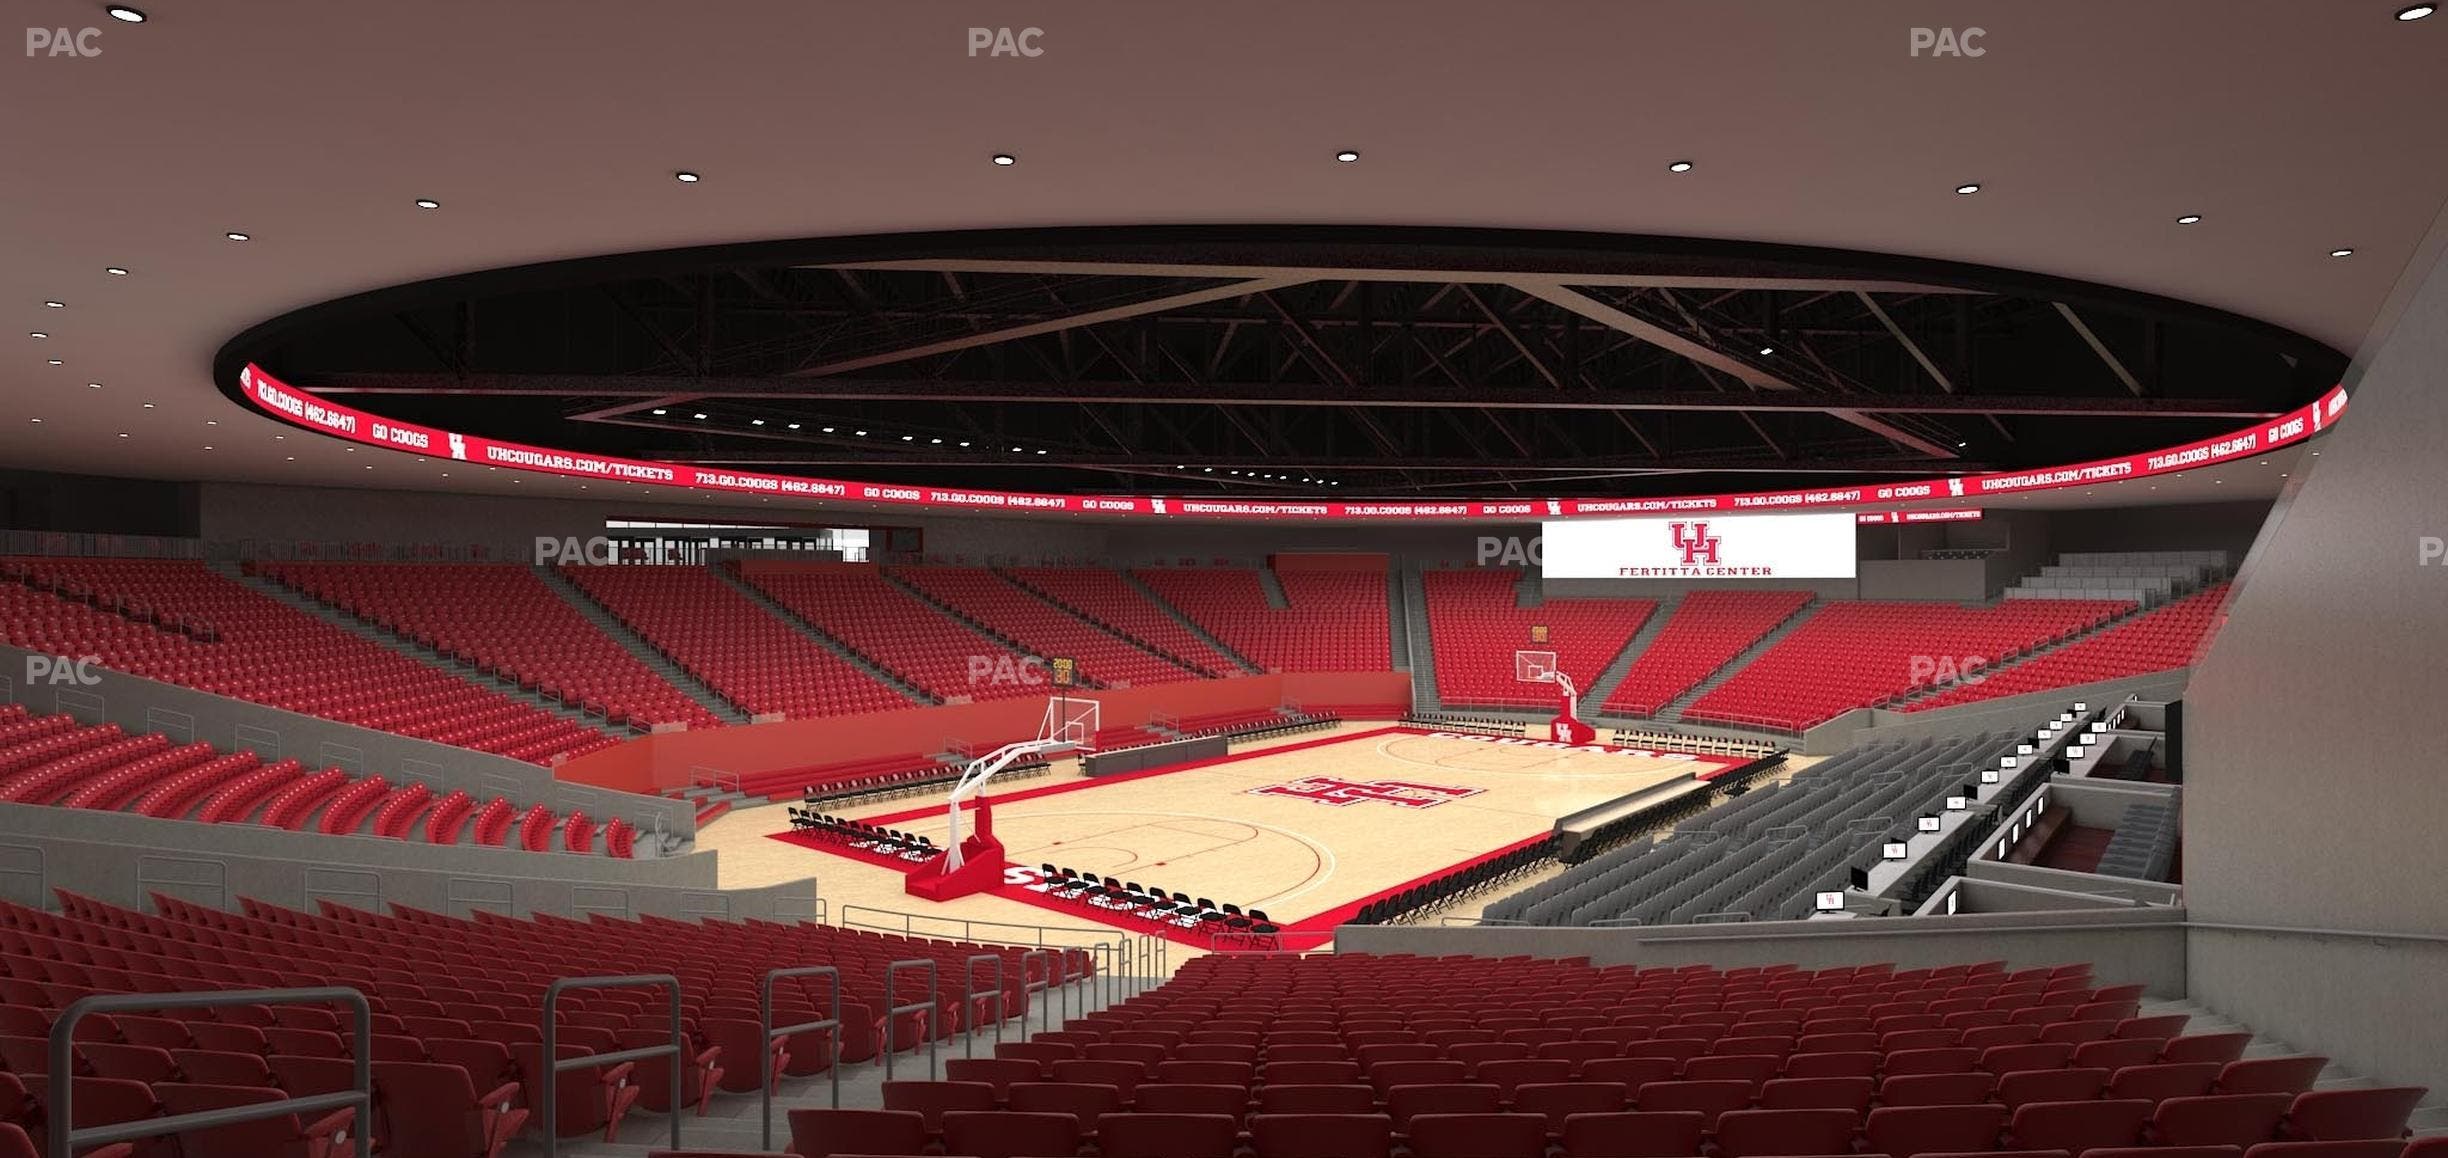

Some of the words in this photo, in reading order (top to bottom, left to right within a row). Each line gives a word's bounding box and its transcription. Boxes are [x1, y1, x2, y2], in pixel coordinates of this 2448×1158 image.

[372, 423, 387, 440] GO
[391, 429, 428, 448] COOGS
[487, 446, 673, 480] UHCOUGARS.COM/TICKETS
[2148, 446, 2209, 470] 713.GO.COOGS
[695, 472, 778, 490] 713.GO.COOGS
[1982, 462, 2132, 490] UHCOUGARS.COM/TICKETS
[863, 487, 879, 498] GO
[1878, 489, 1891, 498] GO
[1895, 486, 1931, 497] COOGS
[1082, 500, 1096, 509] GO
[1100, 501, 1134, 510] COOGS
[1577, 499, 1717, 512] UHCOUGARS.COM/TICKETS
[1669, 521, 1722, 567] UH
[1619, 566, 1701, 577] FERTITTA
[1706, 566, 1772, 576] CENTER
